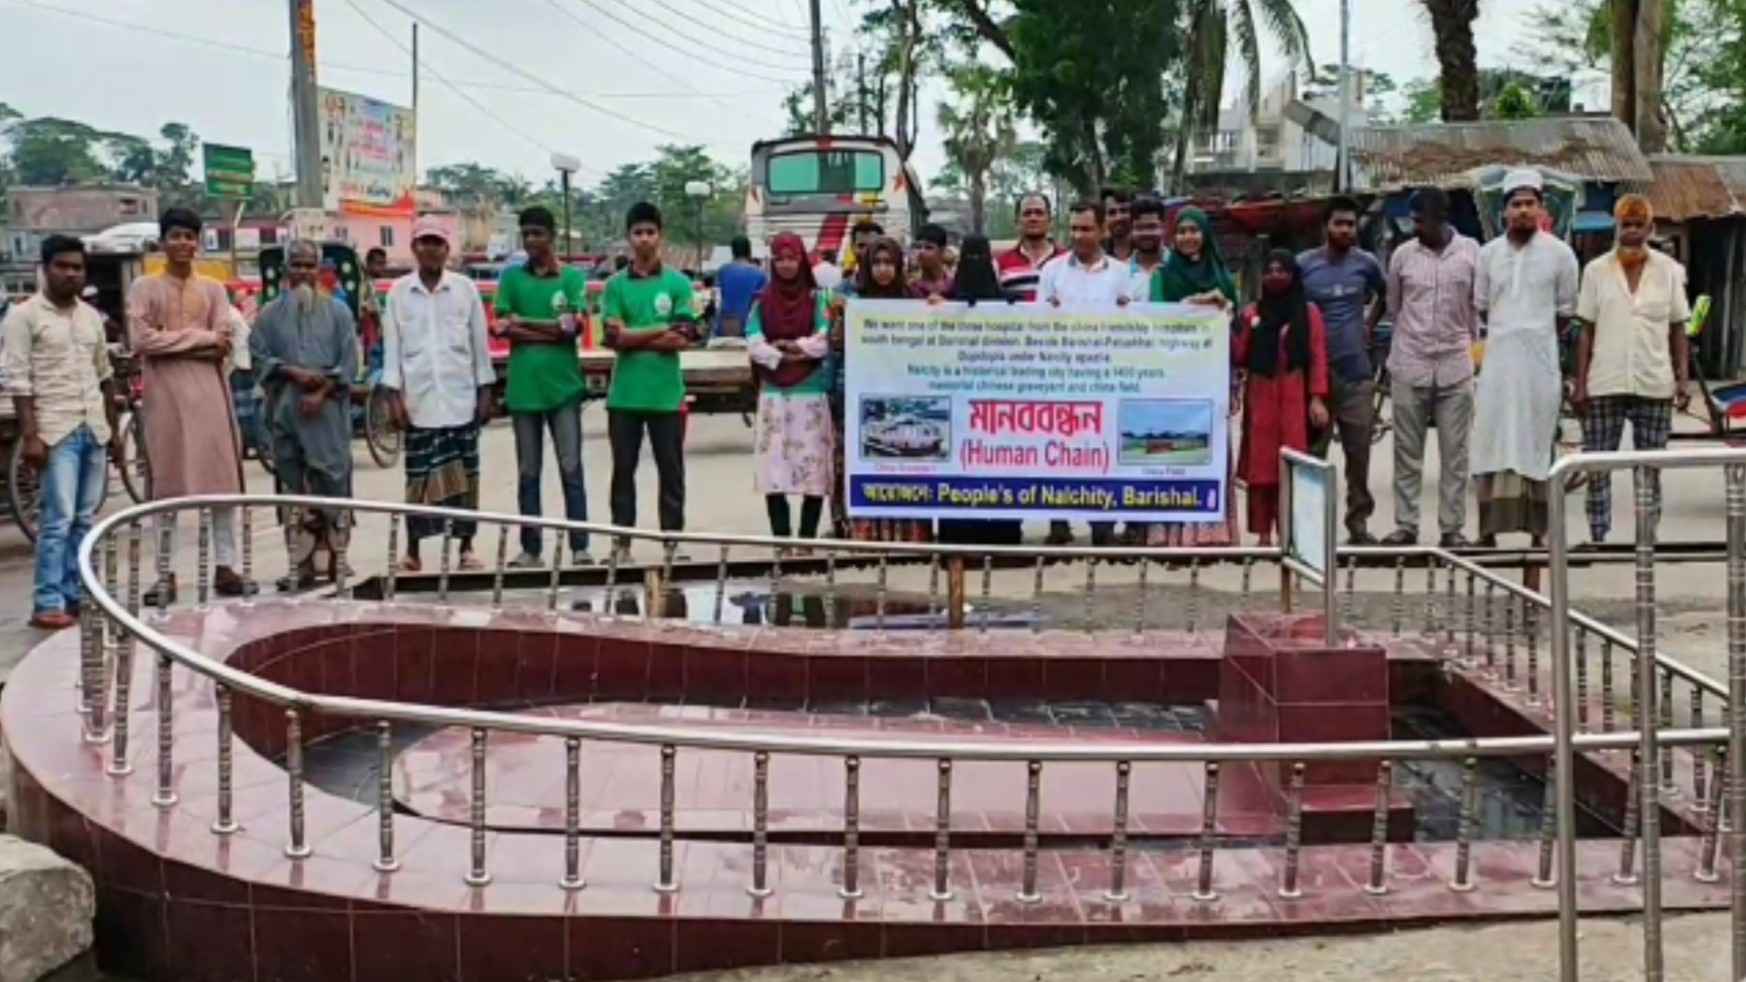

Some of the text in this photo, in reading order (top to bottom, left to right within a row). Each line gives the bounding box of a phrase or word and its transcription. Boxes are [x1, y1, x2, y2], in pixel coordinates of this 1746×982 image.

[940, 320, 955, 331] the
[967, 398, 1104, 437] মানববন্ধন
[960, 438, 1110, 474] (Human Chain)
[937, 482, 1014, 507] People's
[1017, 484, 1038, 503] of
